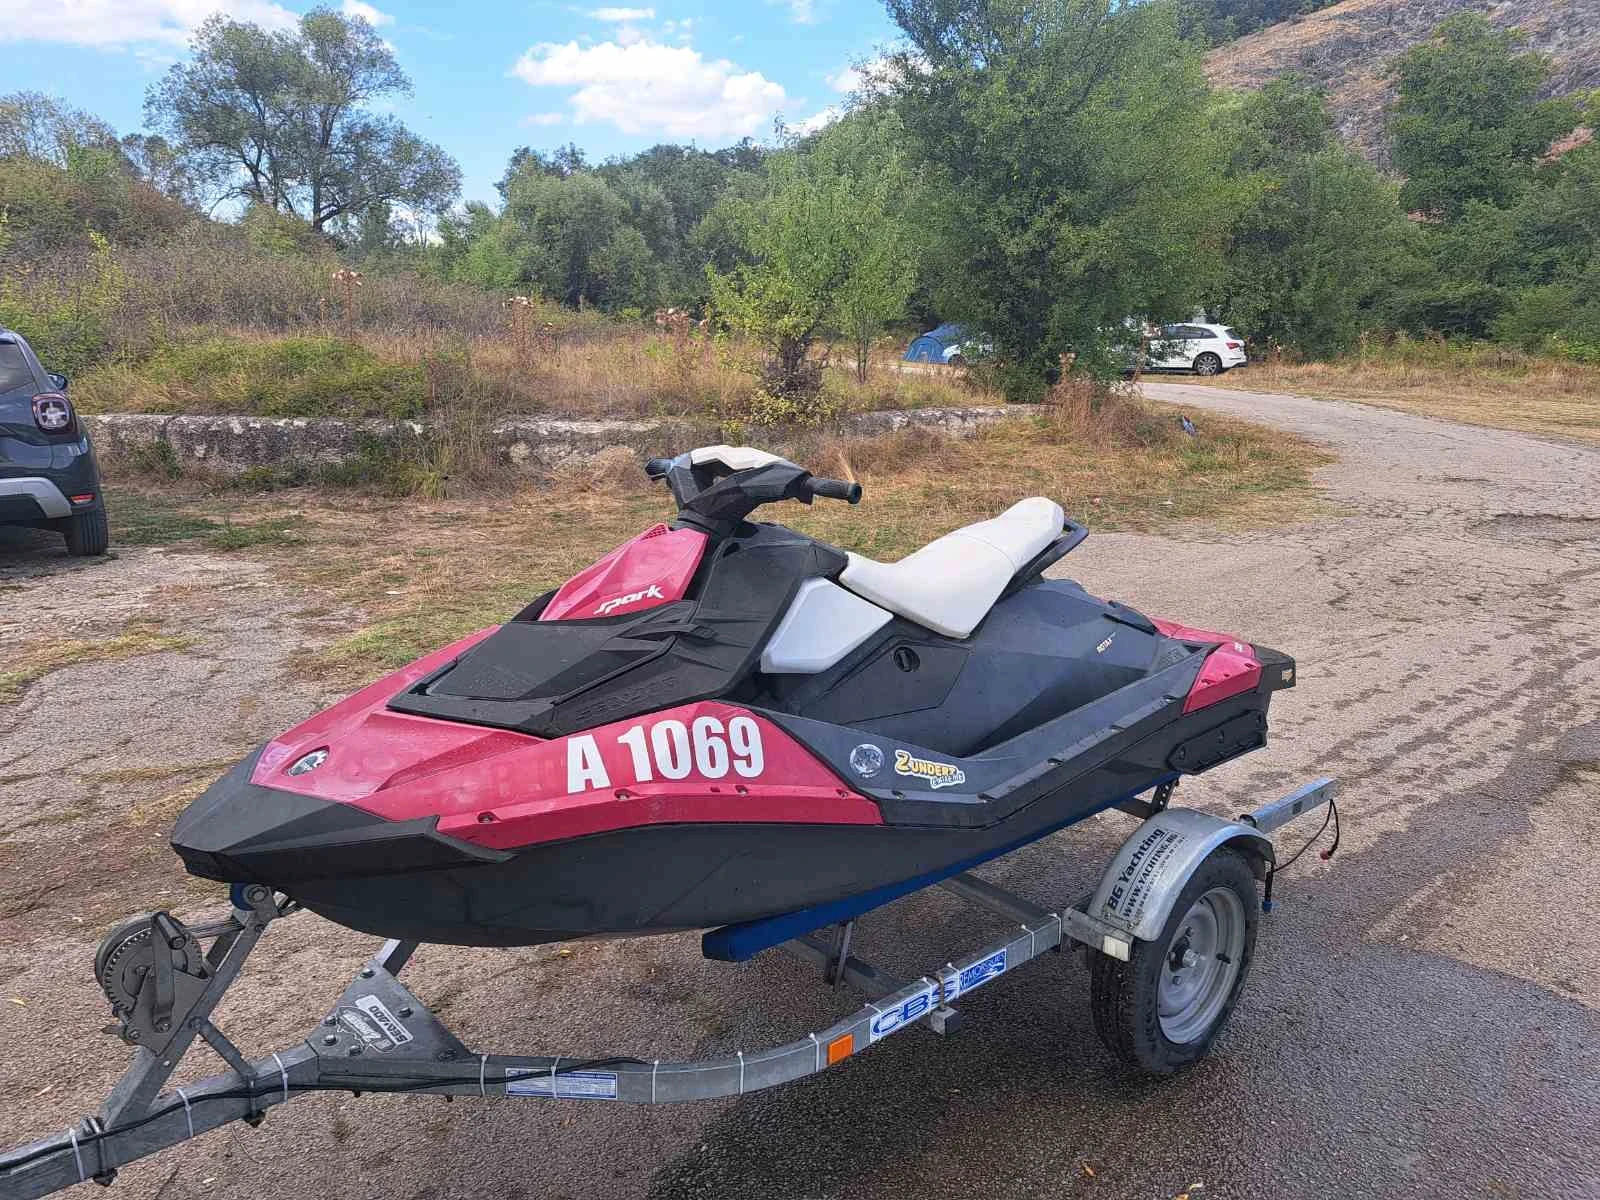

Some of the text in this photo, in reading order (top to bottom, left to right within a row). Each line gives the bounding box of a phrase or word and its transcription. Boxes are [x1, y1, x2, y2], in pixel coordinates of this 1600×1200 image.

[567, 716, 765, 794] A 1069
[1107, 885, 1124, 911] BG
[1118, 828, 1166, 883] Yachting
